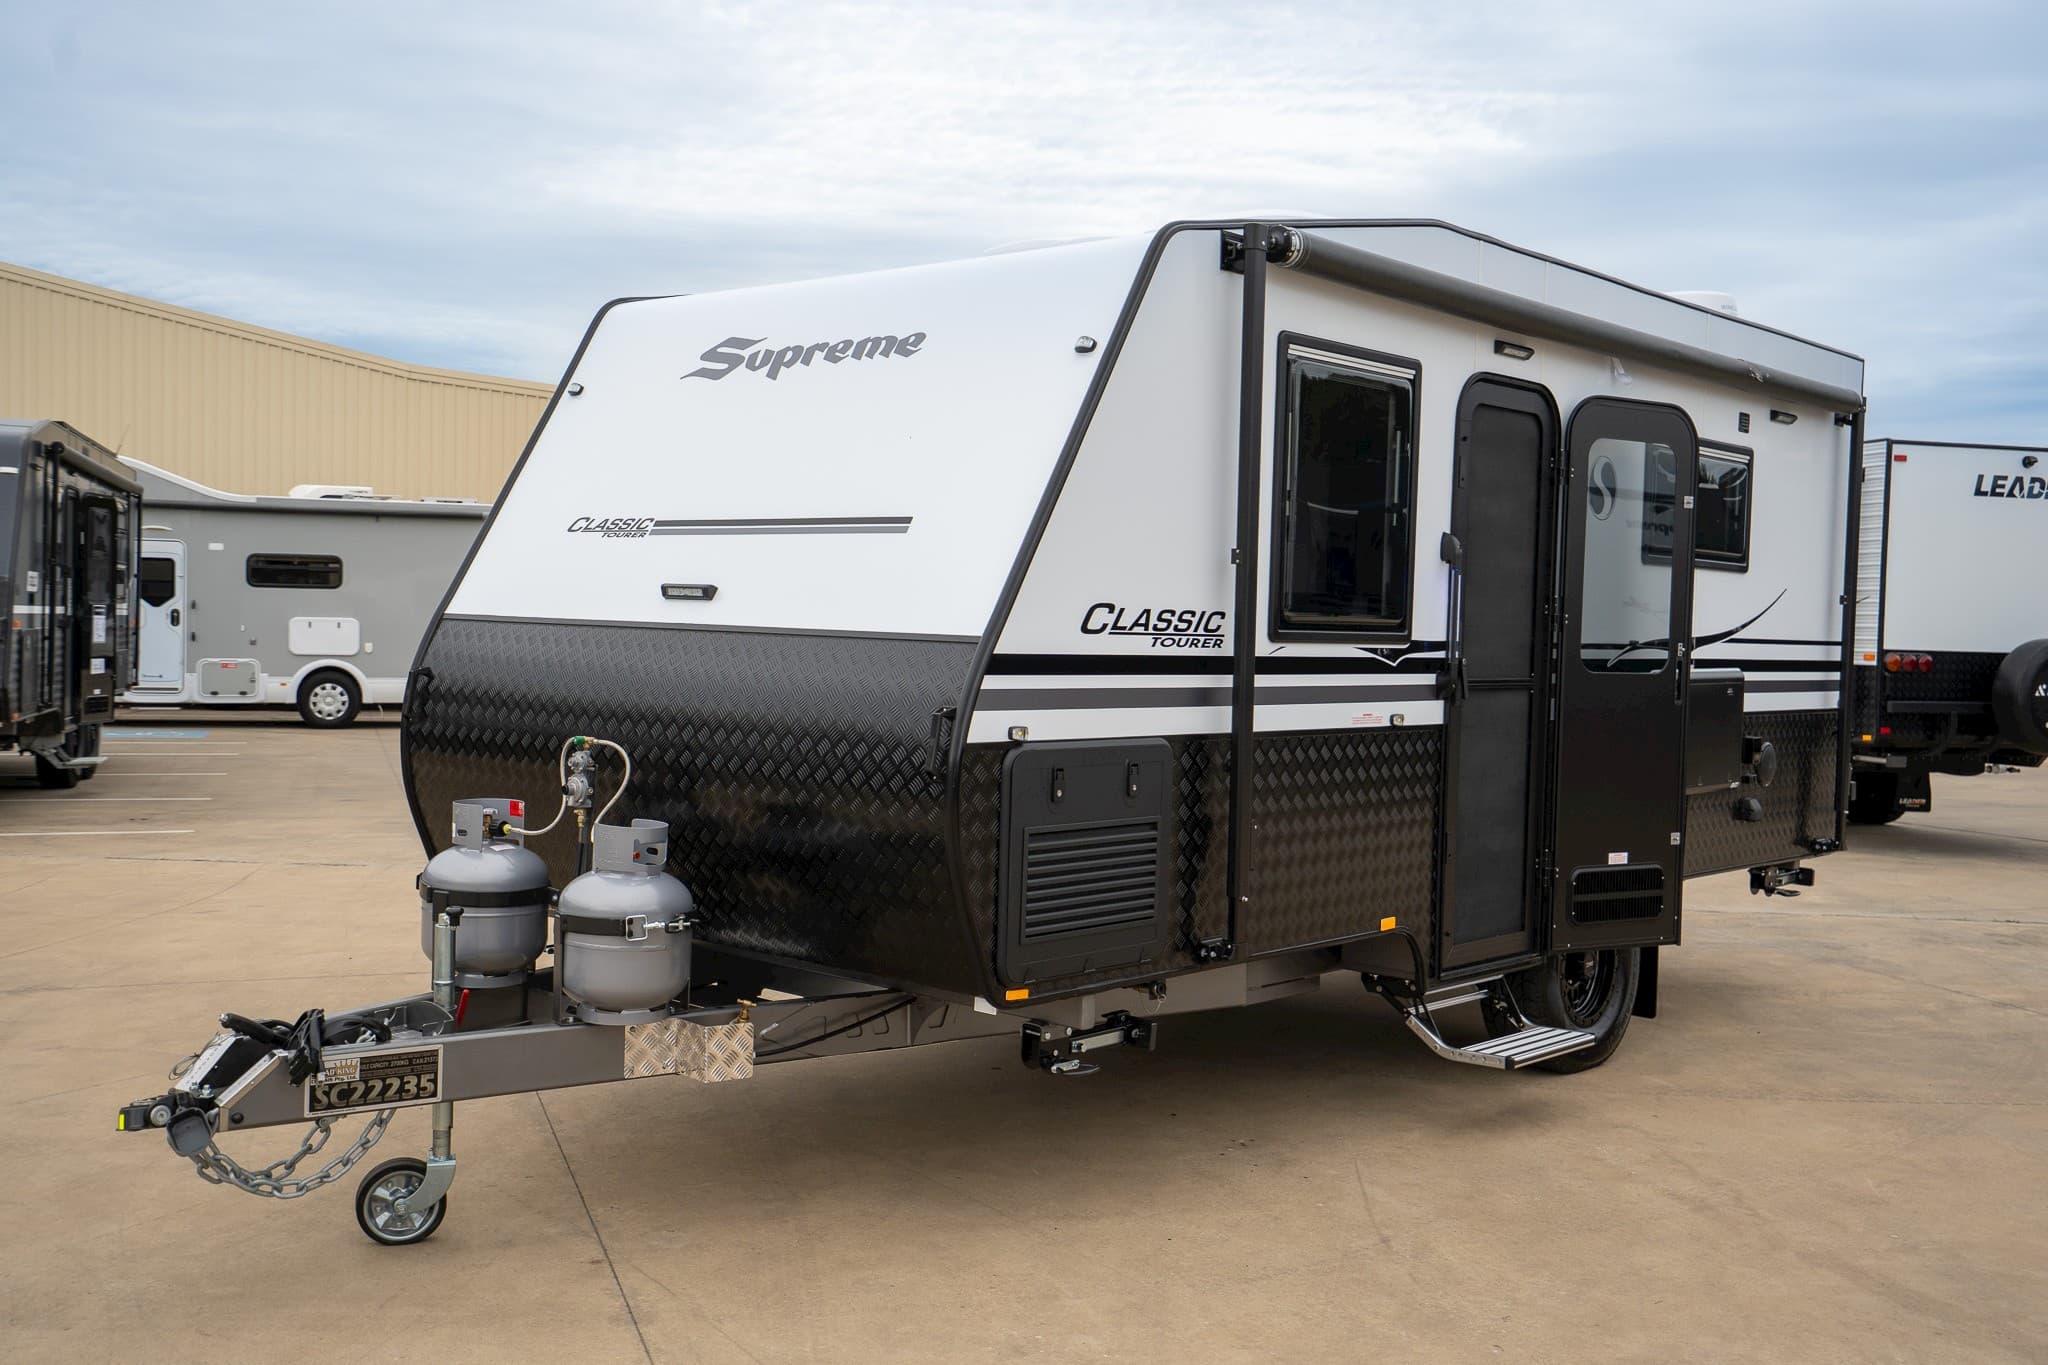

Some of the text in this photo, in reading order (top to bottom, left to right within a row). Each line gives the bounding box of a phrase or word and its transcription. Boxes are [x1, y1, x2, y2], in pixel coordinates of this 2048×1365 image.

[680, 332, 927, 381] Supreme
[1974, 474, 2048, 499] LEAD
[567, 517, 655, 532] CLASSIC
[1080, 603, 1226, 634] CLASSIC
[1151, 637, 1224, 648] TOURER
[314, 1073, 435, 1110] SC22235
